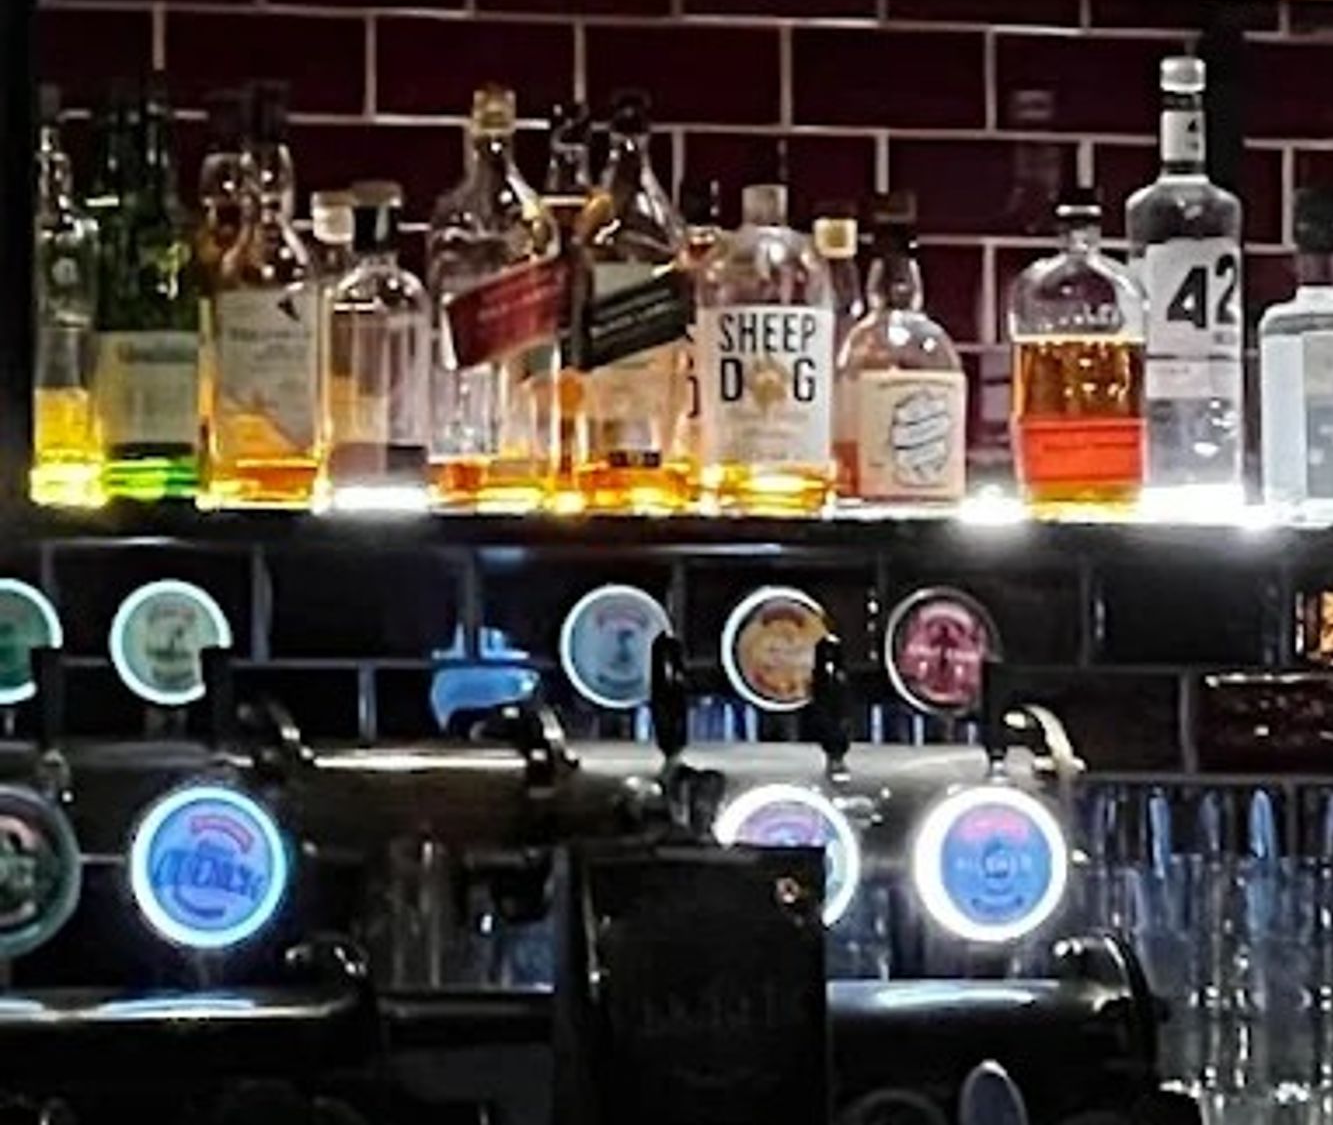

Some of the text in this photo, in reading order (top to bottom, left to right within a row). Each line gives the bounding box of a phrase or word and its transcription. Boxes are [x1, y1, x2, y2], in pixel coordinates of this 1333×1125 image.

[1166, 252, 1239, 330] 42
[718, 312, 818, 354] SHEEP
[719, 357, 817, 403] DG
